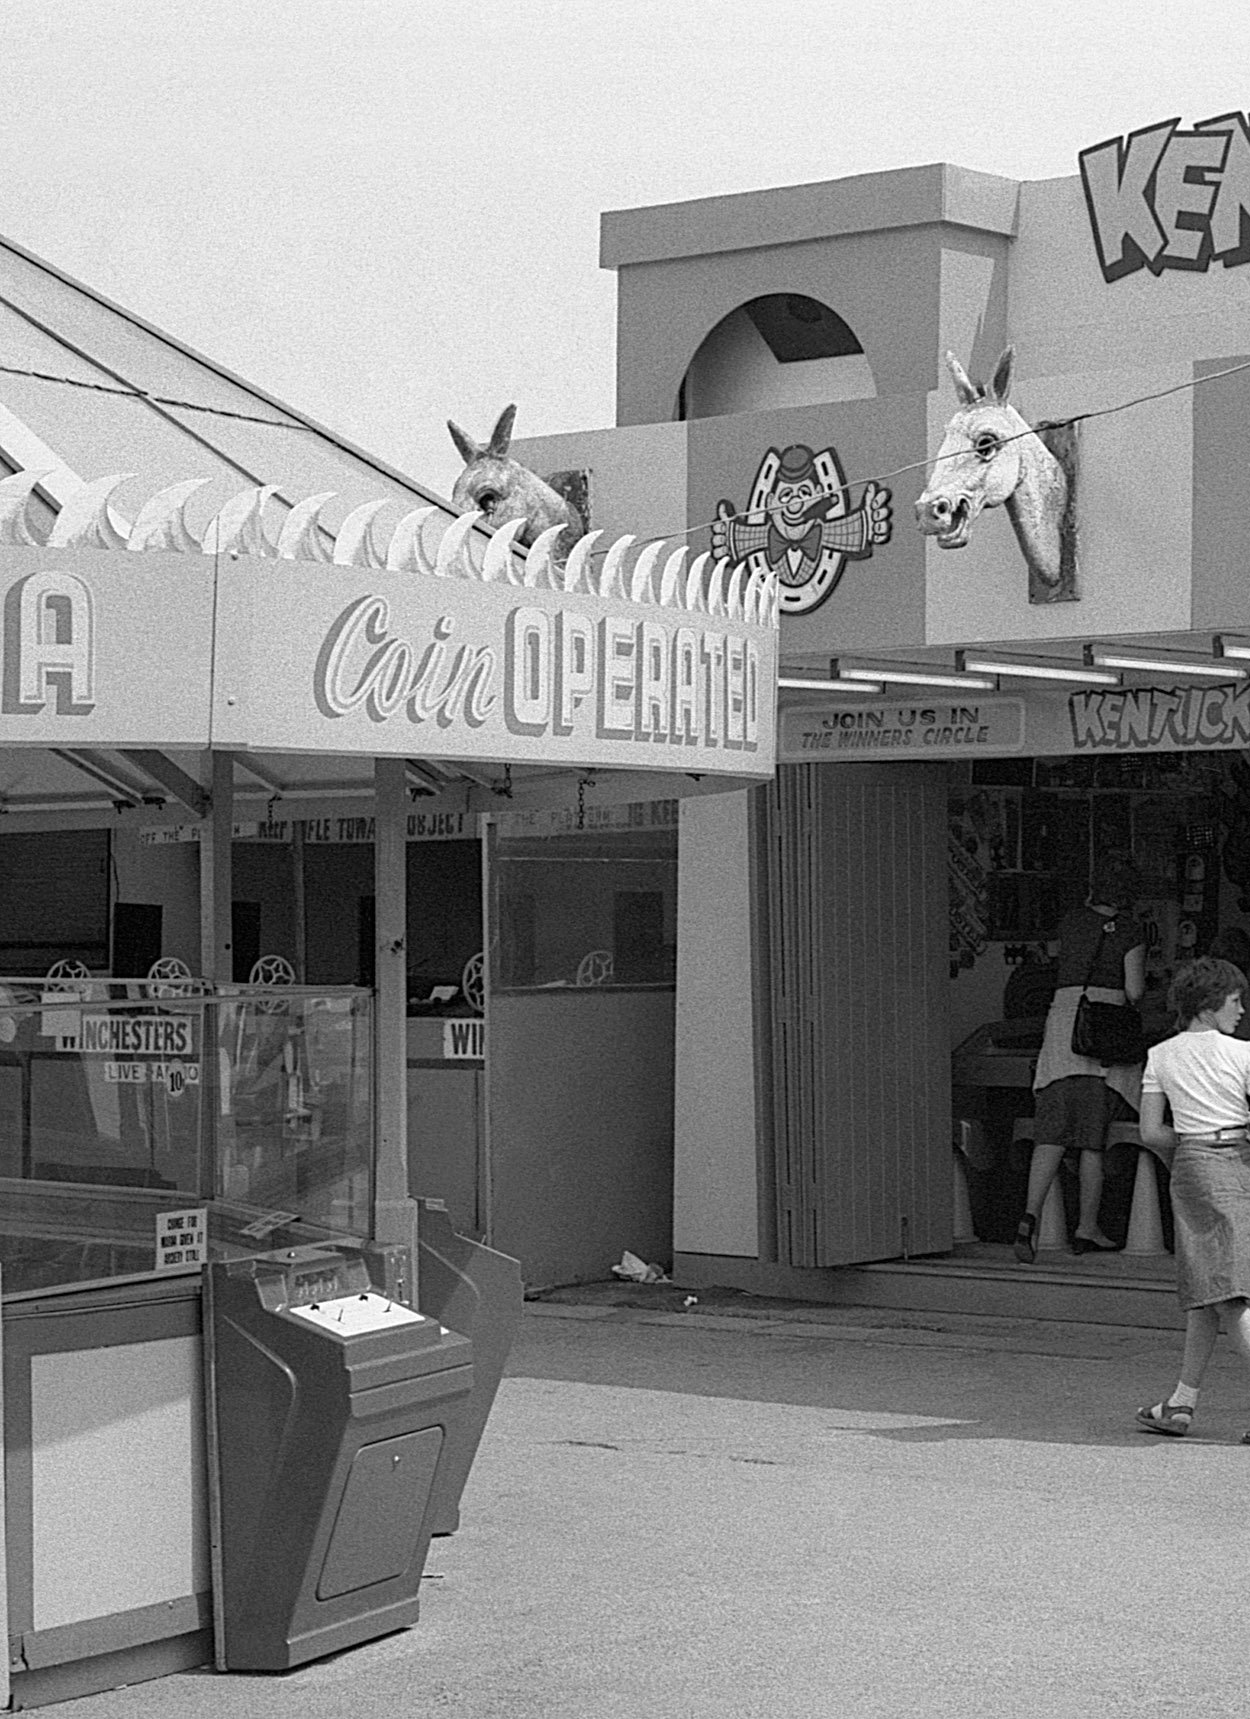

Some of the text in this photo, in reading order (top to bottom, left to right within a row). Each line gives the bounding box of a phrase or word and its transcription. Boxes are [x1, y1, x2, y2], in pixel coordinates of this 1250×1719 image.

[313, 594, 761, 751] Coin OPERATED
[822, 706, 980, 730] JOIN US IN
[802, 726, 990, 749] THE WINNERS CIRCLE
[407, 813, 464, 836] OBJECT
[108, 1064, 140, 1080] LIVE
